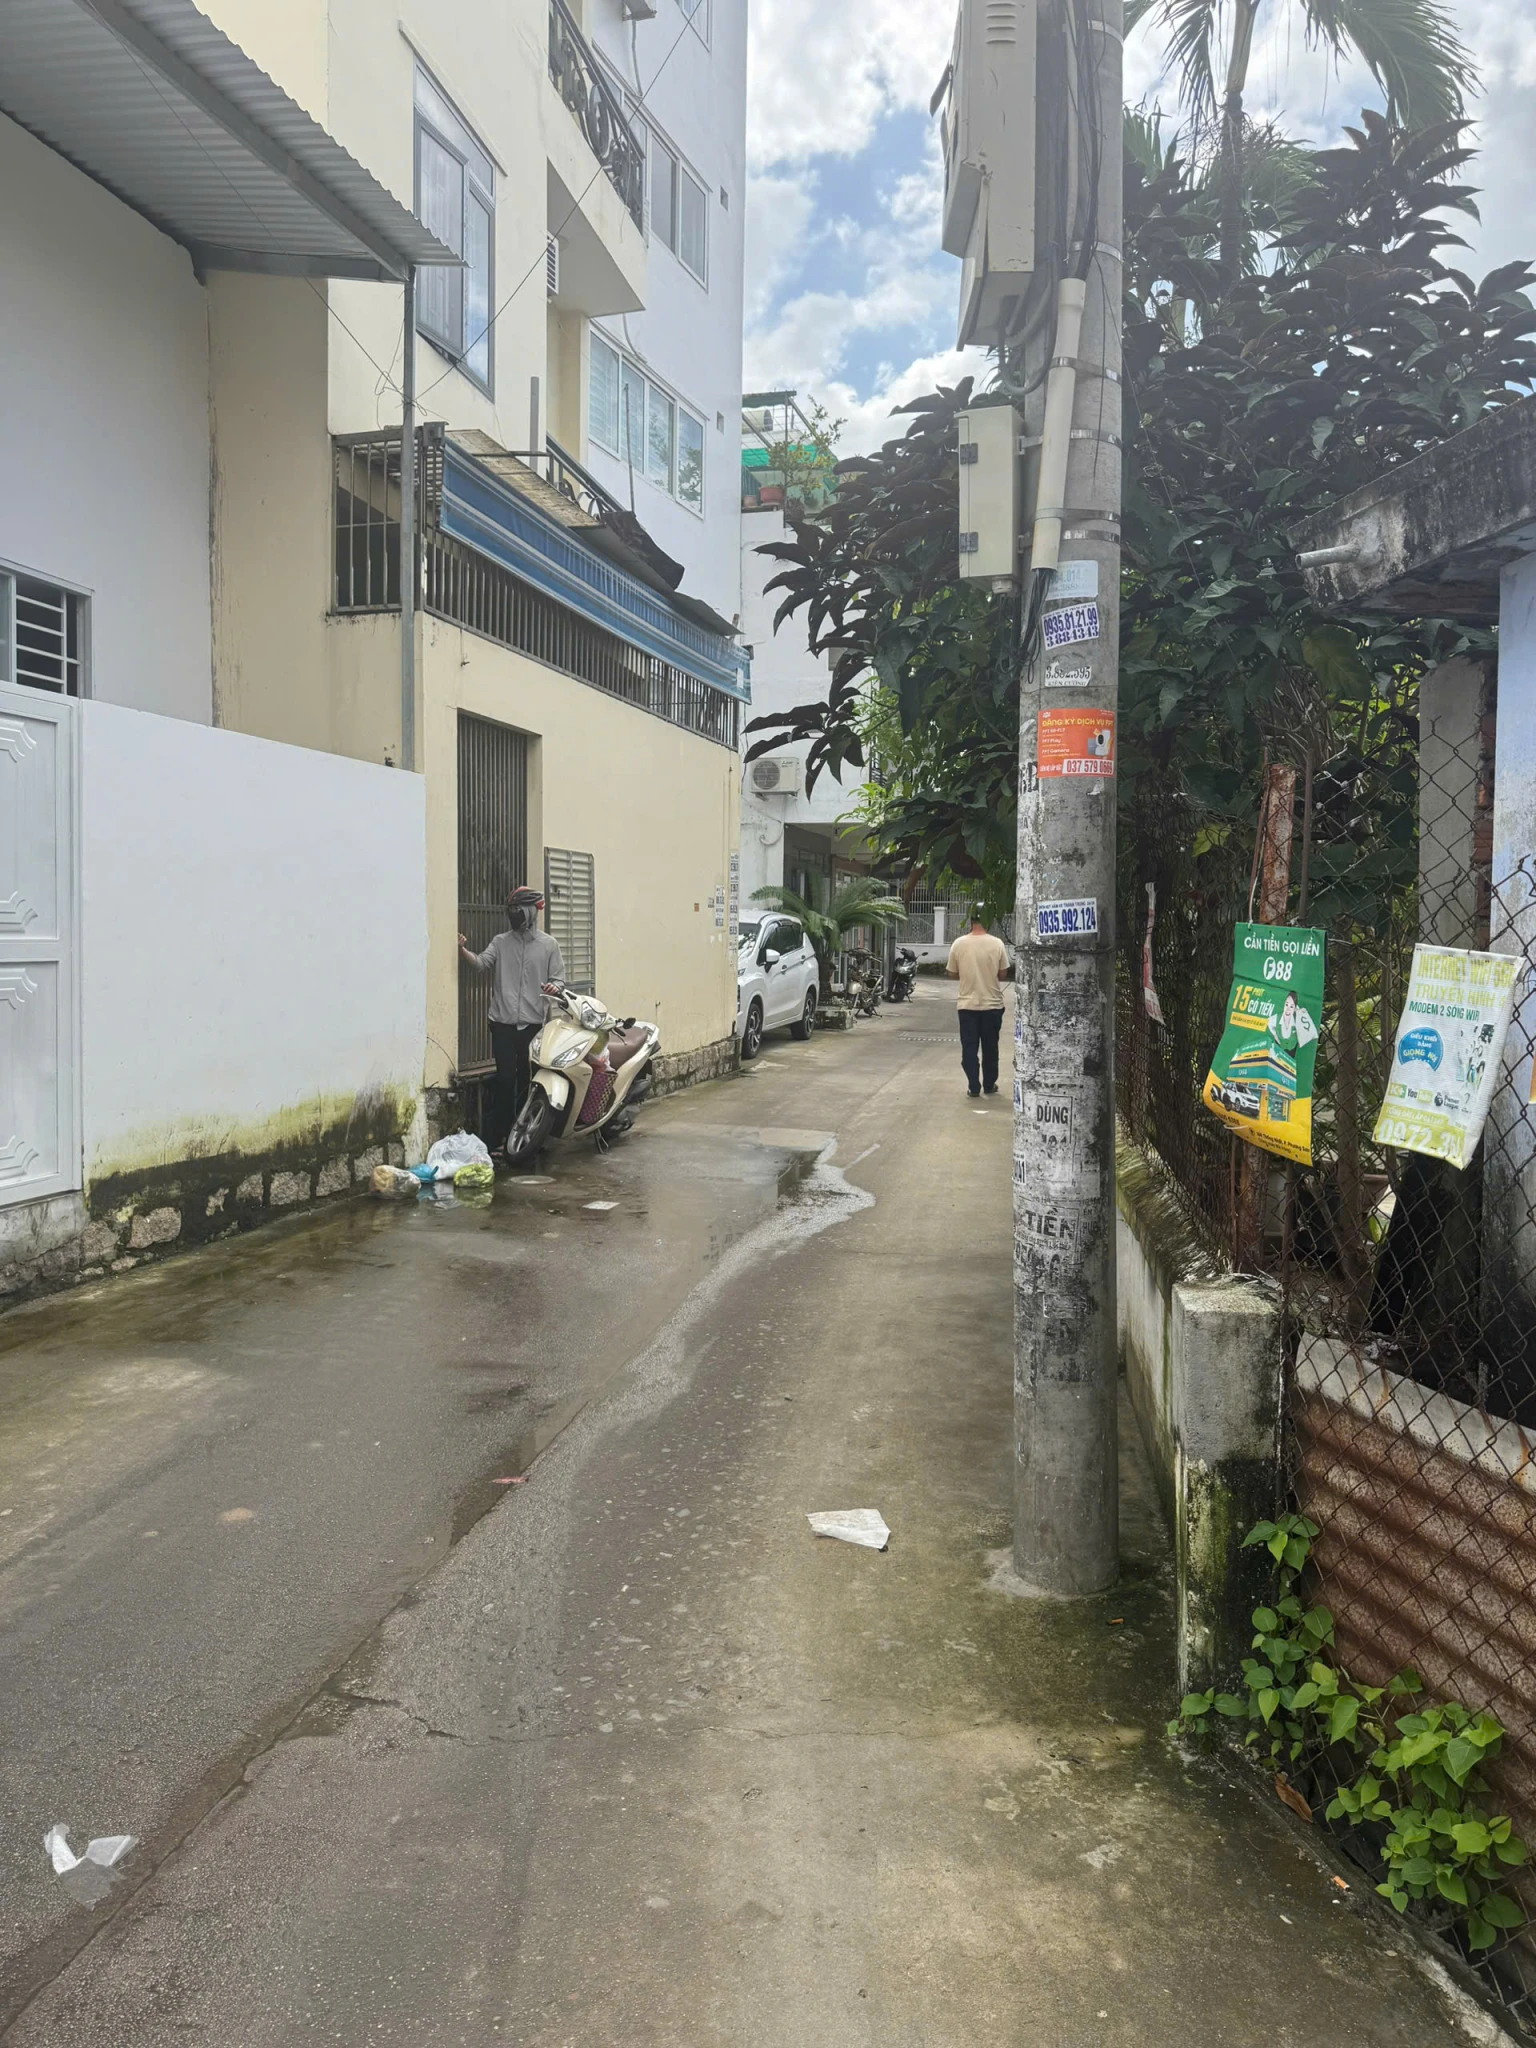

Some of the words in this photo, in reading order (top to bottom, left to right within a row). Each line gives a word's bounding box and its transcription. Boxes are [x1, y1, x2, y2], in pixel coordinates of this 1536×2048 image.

[1043, 607, 1098, 637] 0935.81.21.99
[1076, 718, 1095, 726] DỊCH
[1066, 760, 1082, 773] 037
[1083, 760, 1098, 773] 579
[1038, 907, 1096, 933] 0935.992.124
[1263, 933, 1280, 952] TIỀN
[1282, 940, 1299, 957] GỌI
[1263, 956, 1293, 981] F88
[1417, 953, 1467, 983] INTERNET
[1232, 984, 1253, 1011] 15
[1247, 998, 1259, 1013] CÓ
[1408, 1000, 1439, 1015] MODEM
[1439, 1006, 1445, 1016] 2
[1036, 1100, 1069, 1124] DÙNG
